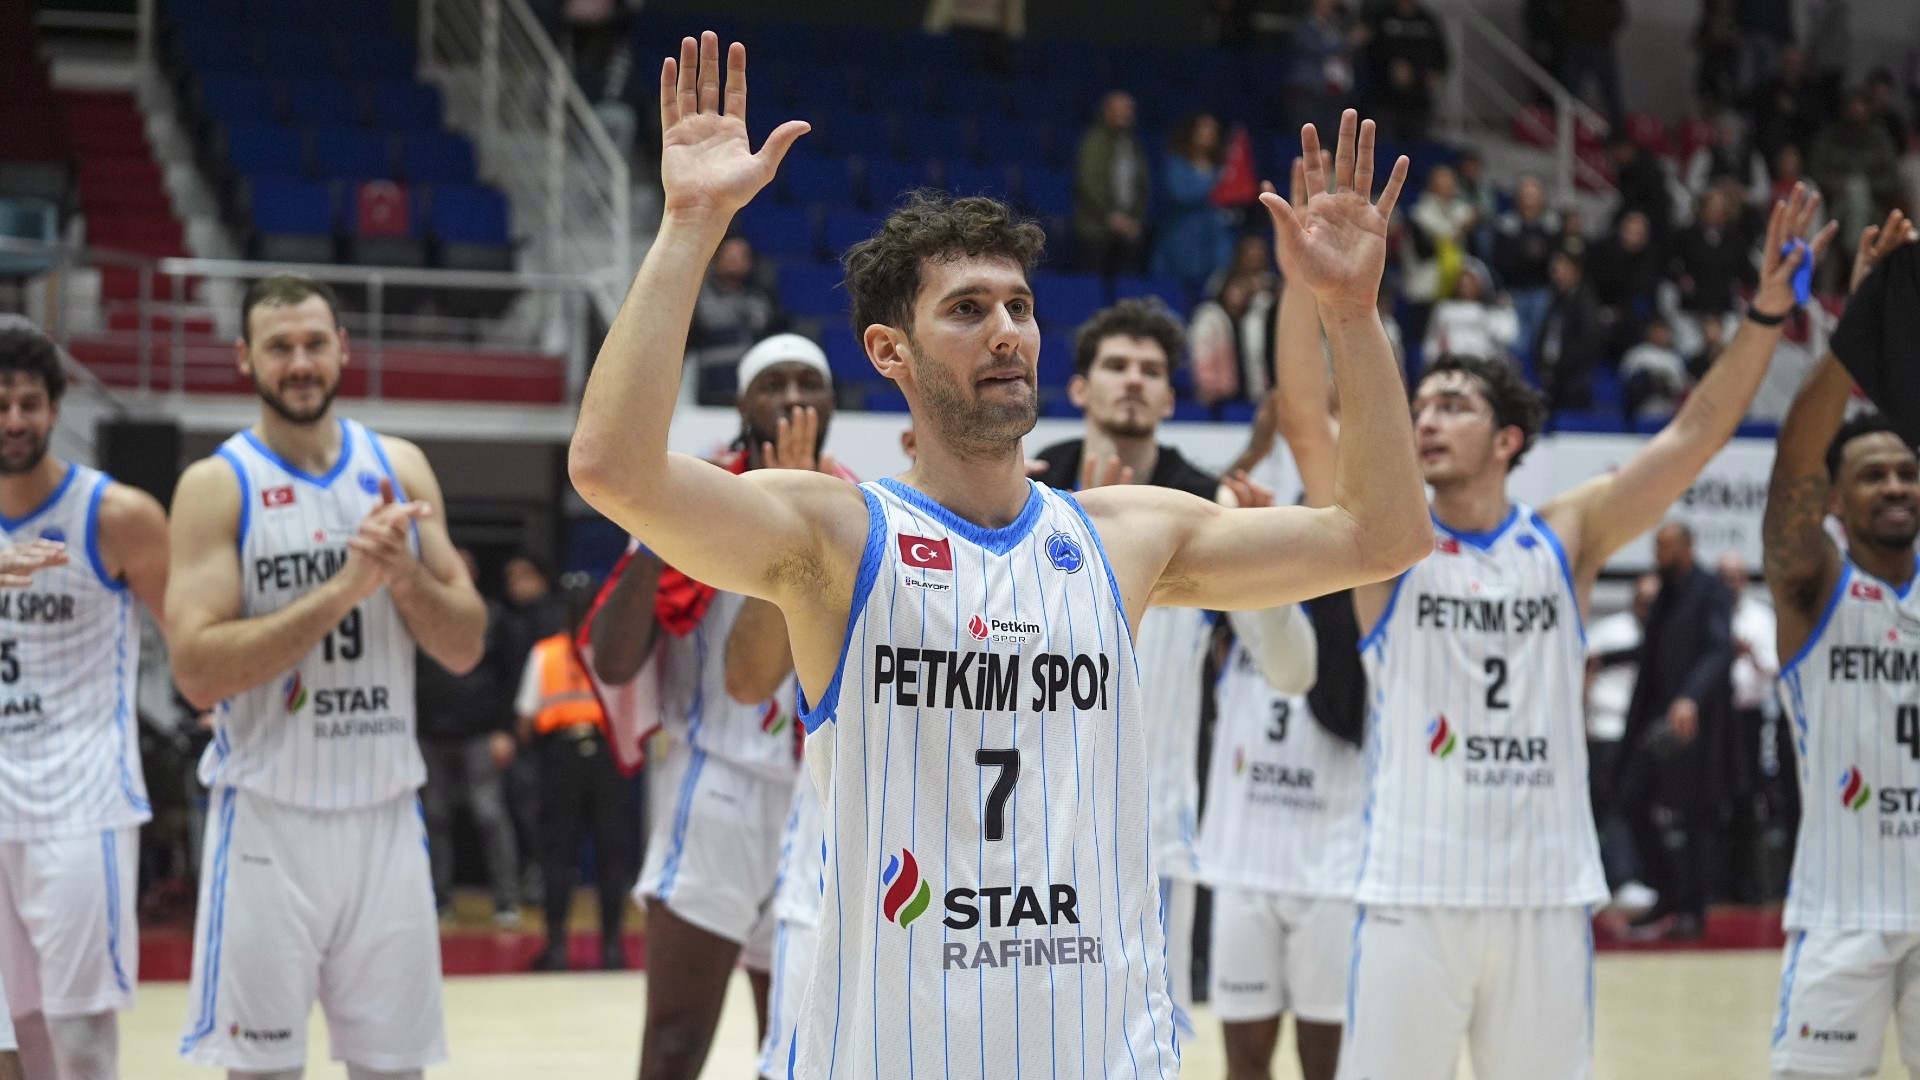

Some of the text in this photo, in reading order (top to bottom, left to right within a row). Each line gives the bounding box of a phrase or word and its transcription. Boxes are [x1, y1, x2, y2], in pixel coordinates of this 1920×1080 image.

[911, 579, 950, 591] PLAYOFF
[17, 591, 75, 623] SPOR
[991, 619, 1040, 634] Petkim
[992, 634, 1027, 643] SPOR
[1031, 652, 1110, 713] SPOR
[1484, 656, 1509, 709] 2
[314, 686, 389, 716] STAR
[1267, 699, 1290, 742] 3
[1896, 703, 1920, 760] 4
[1466, 735, 1548, 762] STAR
[1251, 761, 1314, 789] STAR
[974, 748, 1021, 842] 7
[1878, 786, 1920, 814] ST
[942, 883, 1080, 930] STAR
